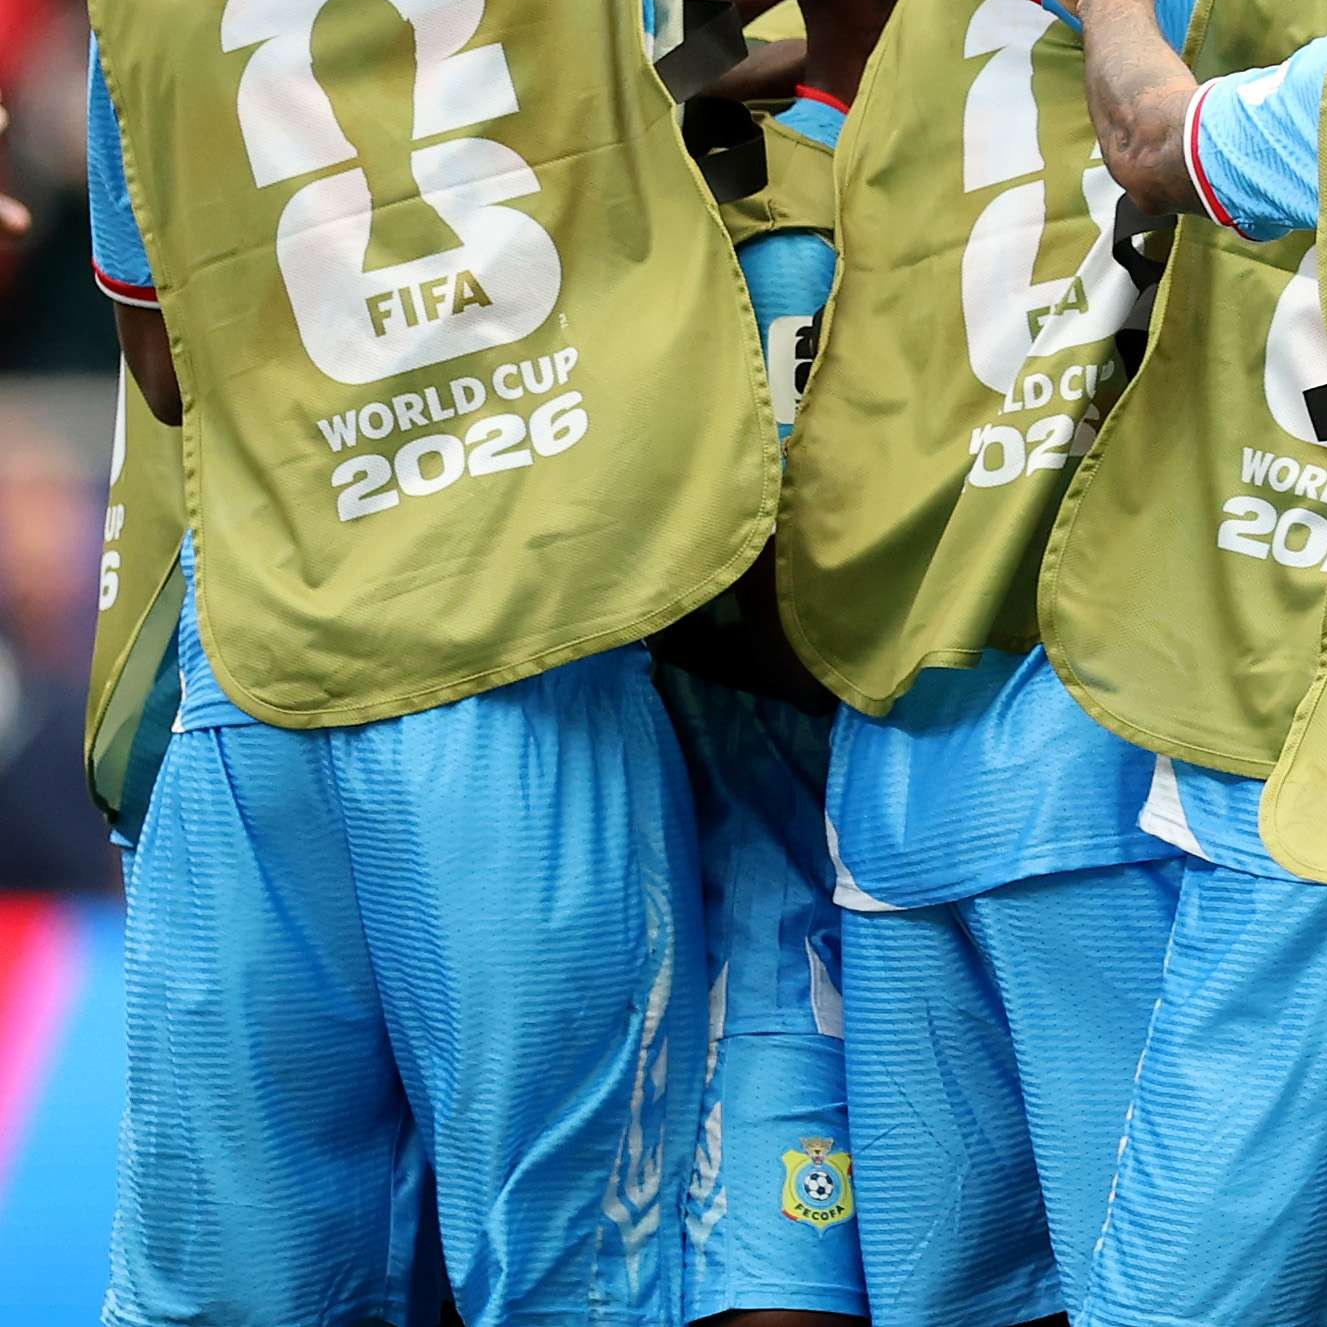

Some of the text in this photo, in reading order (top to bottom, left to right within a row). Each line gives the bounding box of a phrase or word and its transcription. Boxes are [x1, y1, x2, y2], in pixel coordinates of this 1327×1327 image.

[365, 270, 493, 337] FIFA
[316, 346, 579, 452] WORLD CUP
[331, 391, 589, 522] 2026
[794, 1203, 845, 1221] FECOFA
